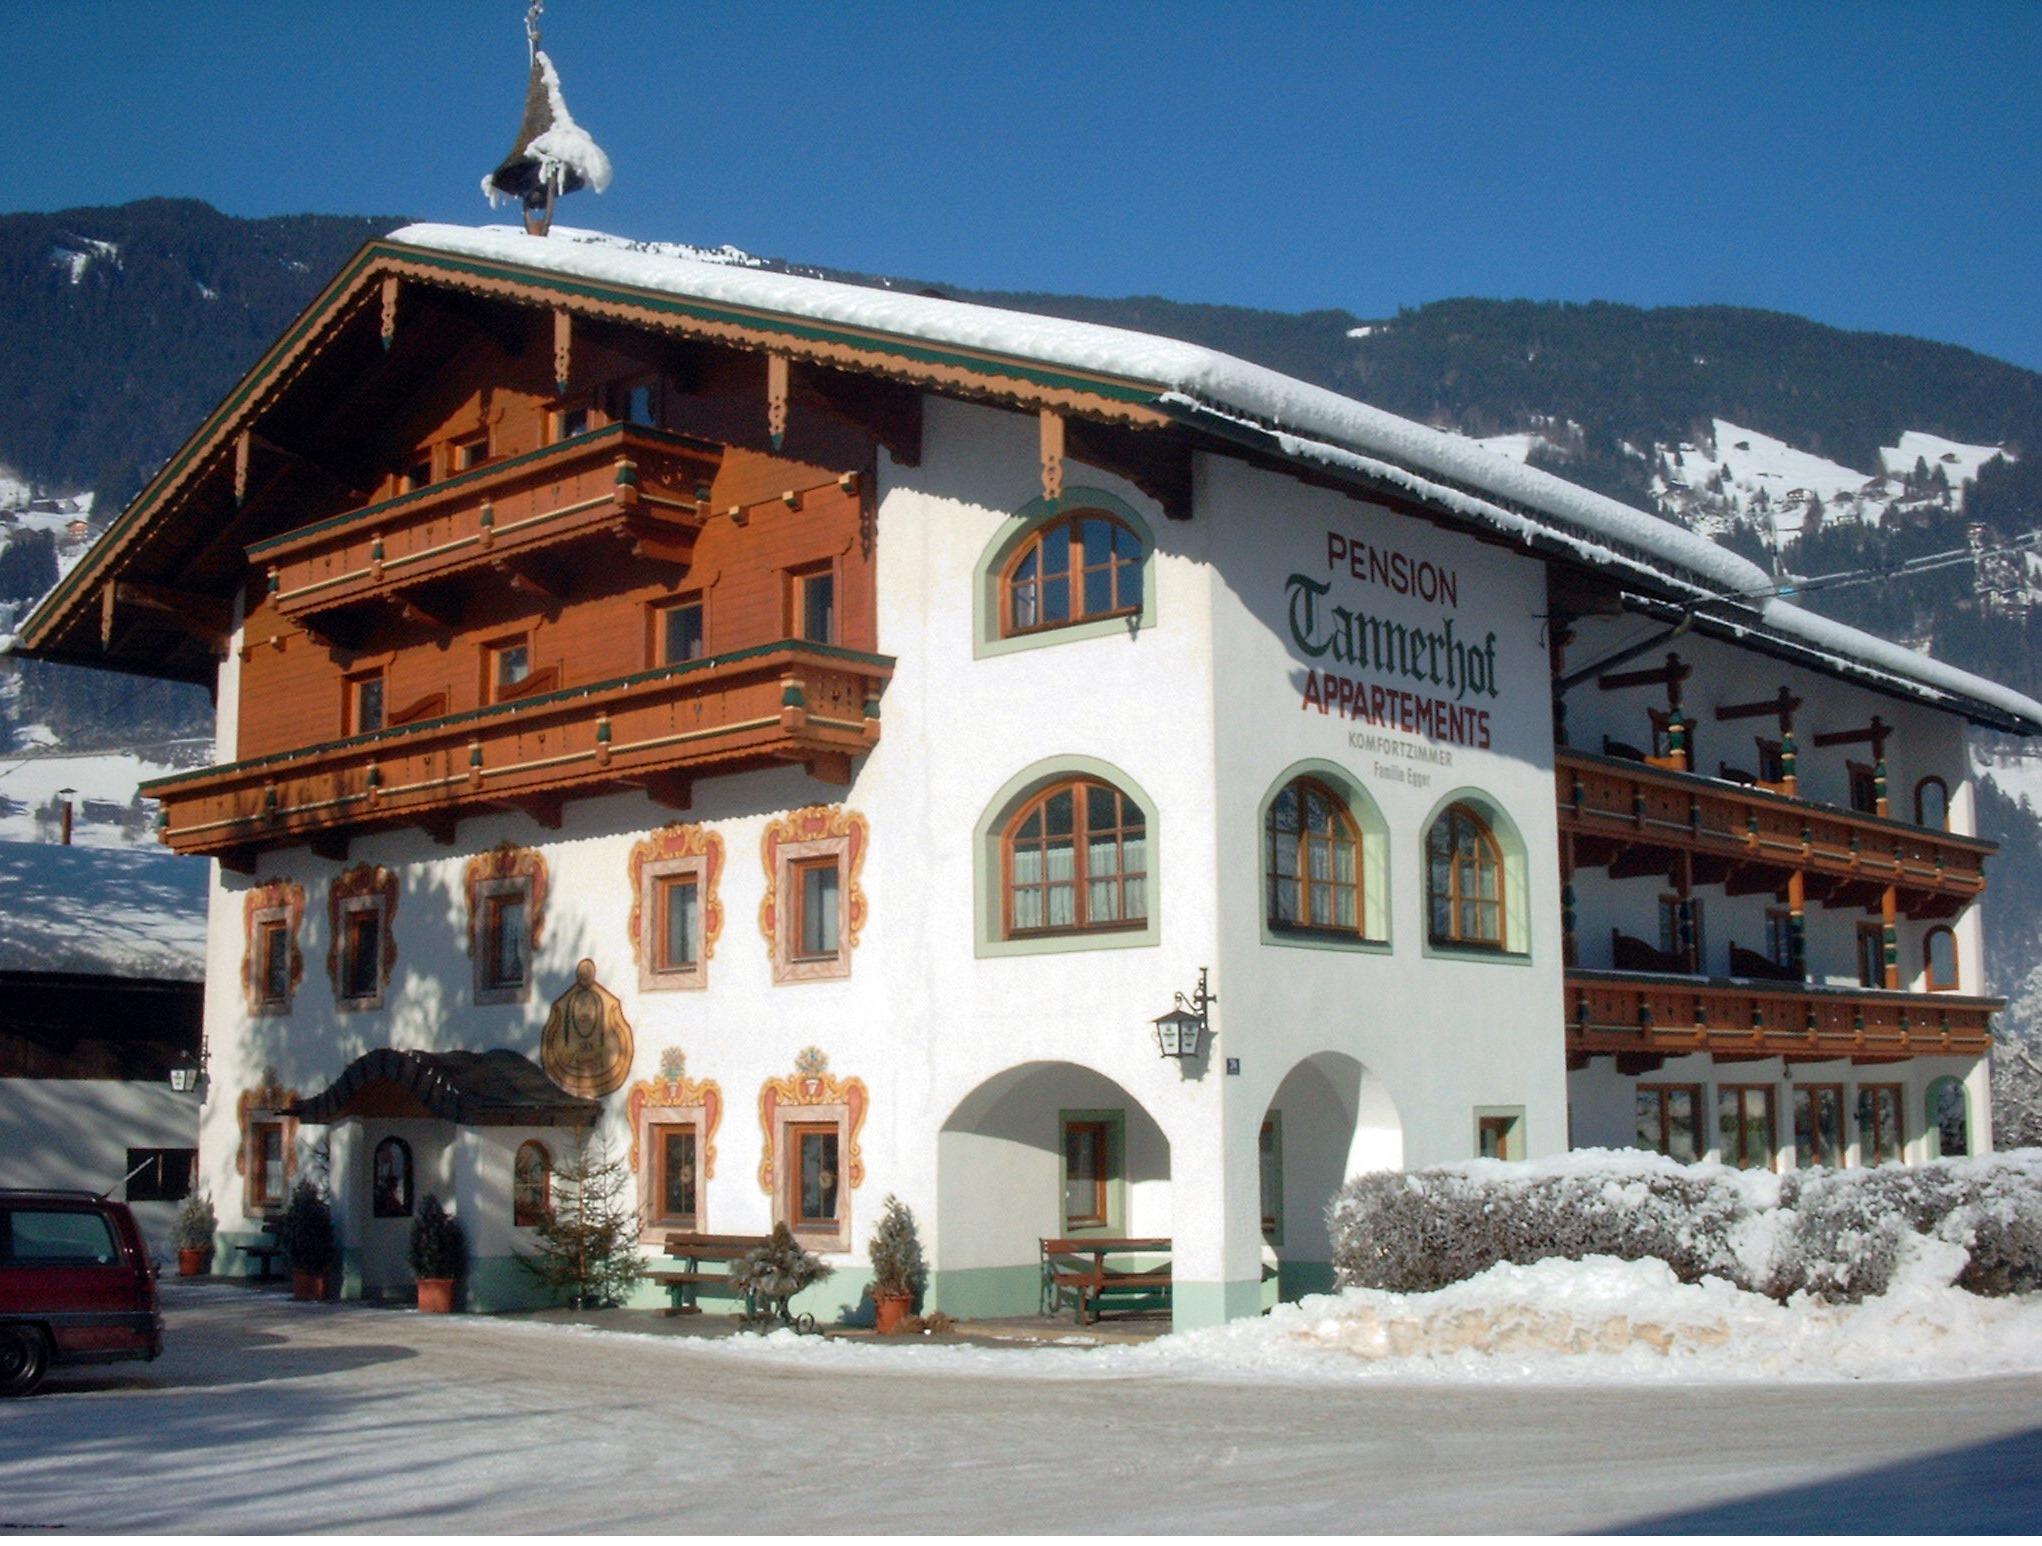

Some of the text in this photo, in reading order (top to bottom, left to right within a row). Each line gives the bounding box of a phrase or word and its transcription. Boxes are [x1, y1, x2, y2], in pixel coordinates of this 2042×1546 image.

[1327, 531, 1457, 609] PENSION
[1285, 573, 1498, 701] Tannerhof
[1302, 669, 1491, 750] APPARTEMENTS
[1348, 731, 1453, 766] KOMFORTZIMMER
